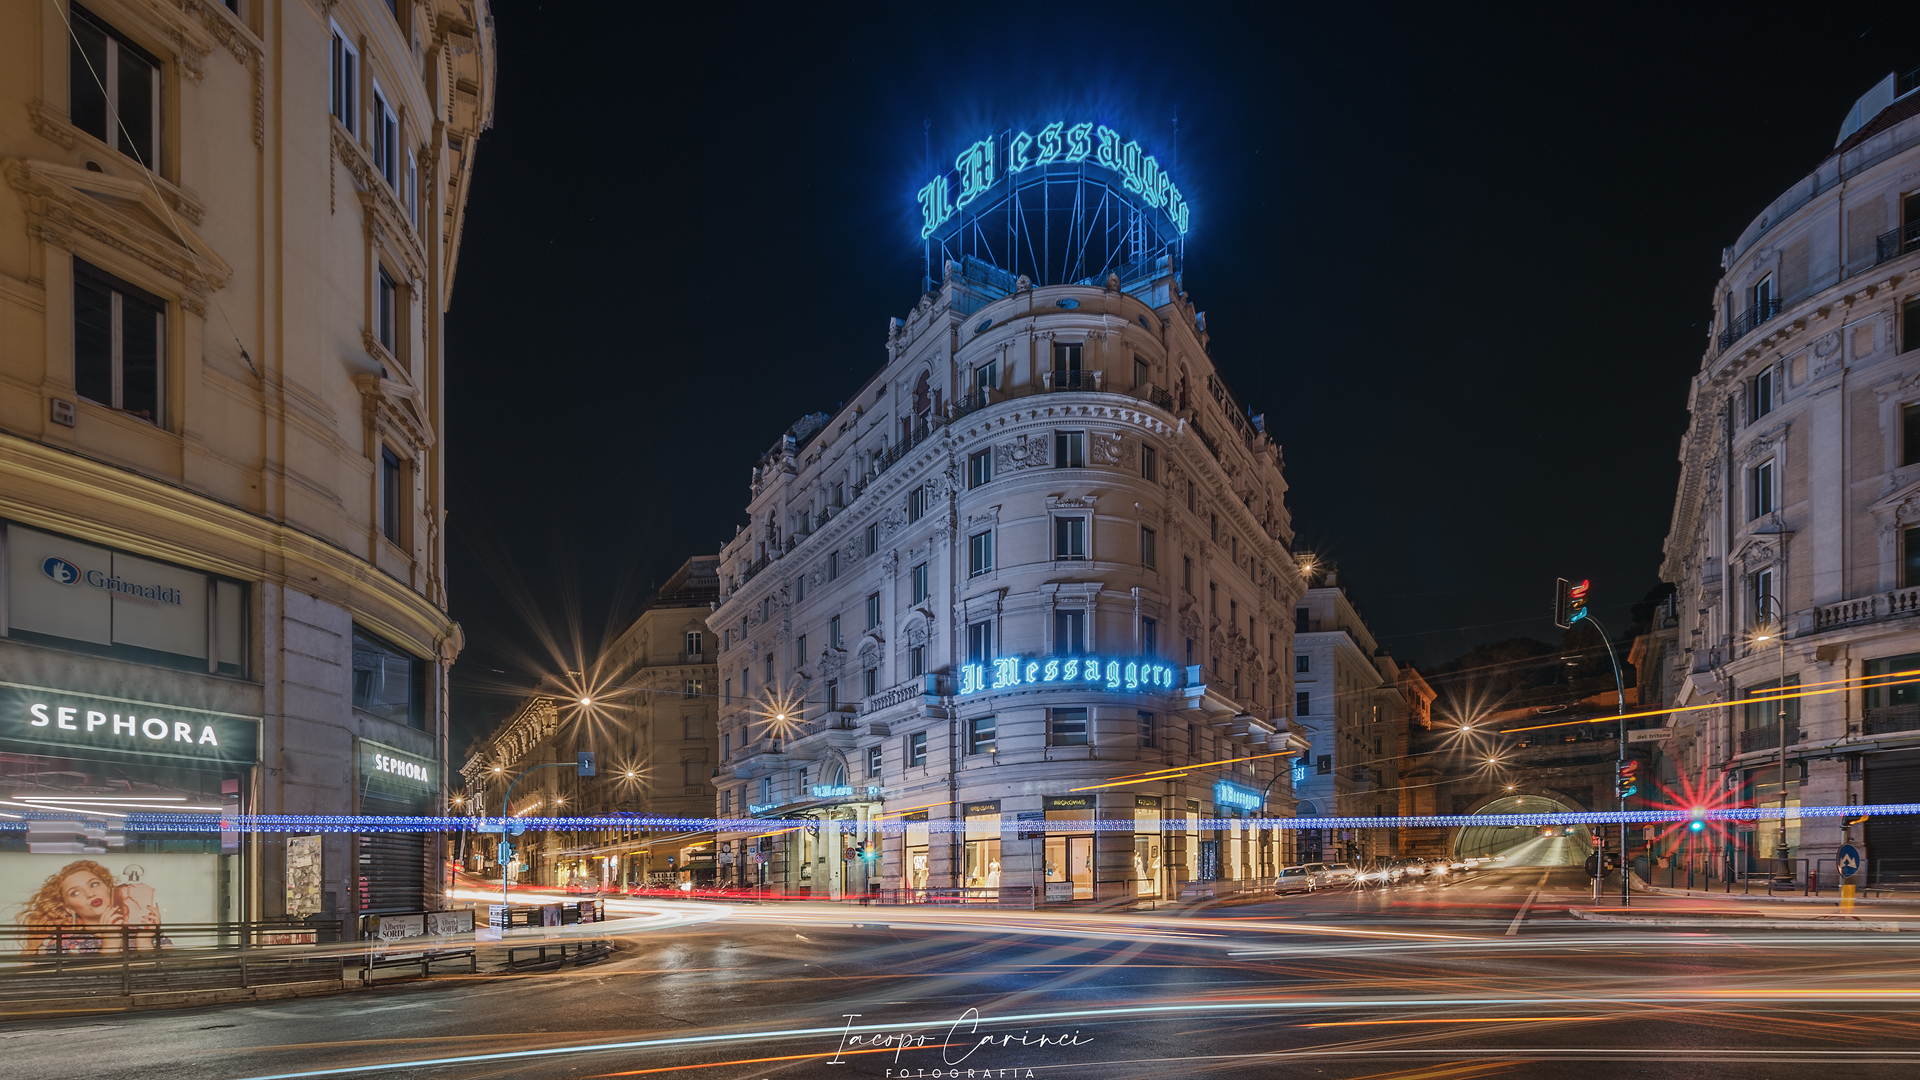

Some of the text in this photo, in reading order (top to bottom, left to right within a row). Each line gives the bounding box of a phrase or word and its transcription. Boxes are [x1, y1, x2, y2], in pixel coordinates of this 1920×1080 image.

[918, 121, 1189, 239] Il Messaggero
[86, 569, 182, 605] Grimaldi
[961, 657, 1172, 695] Il Messaggero
[30, 703, 218, 746] SEPHORA
[375, 753, 428, 782] SEPHORA
[382, 930, 405, 938] SORDI
[384, 923, 406, 931] Alberto
